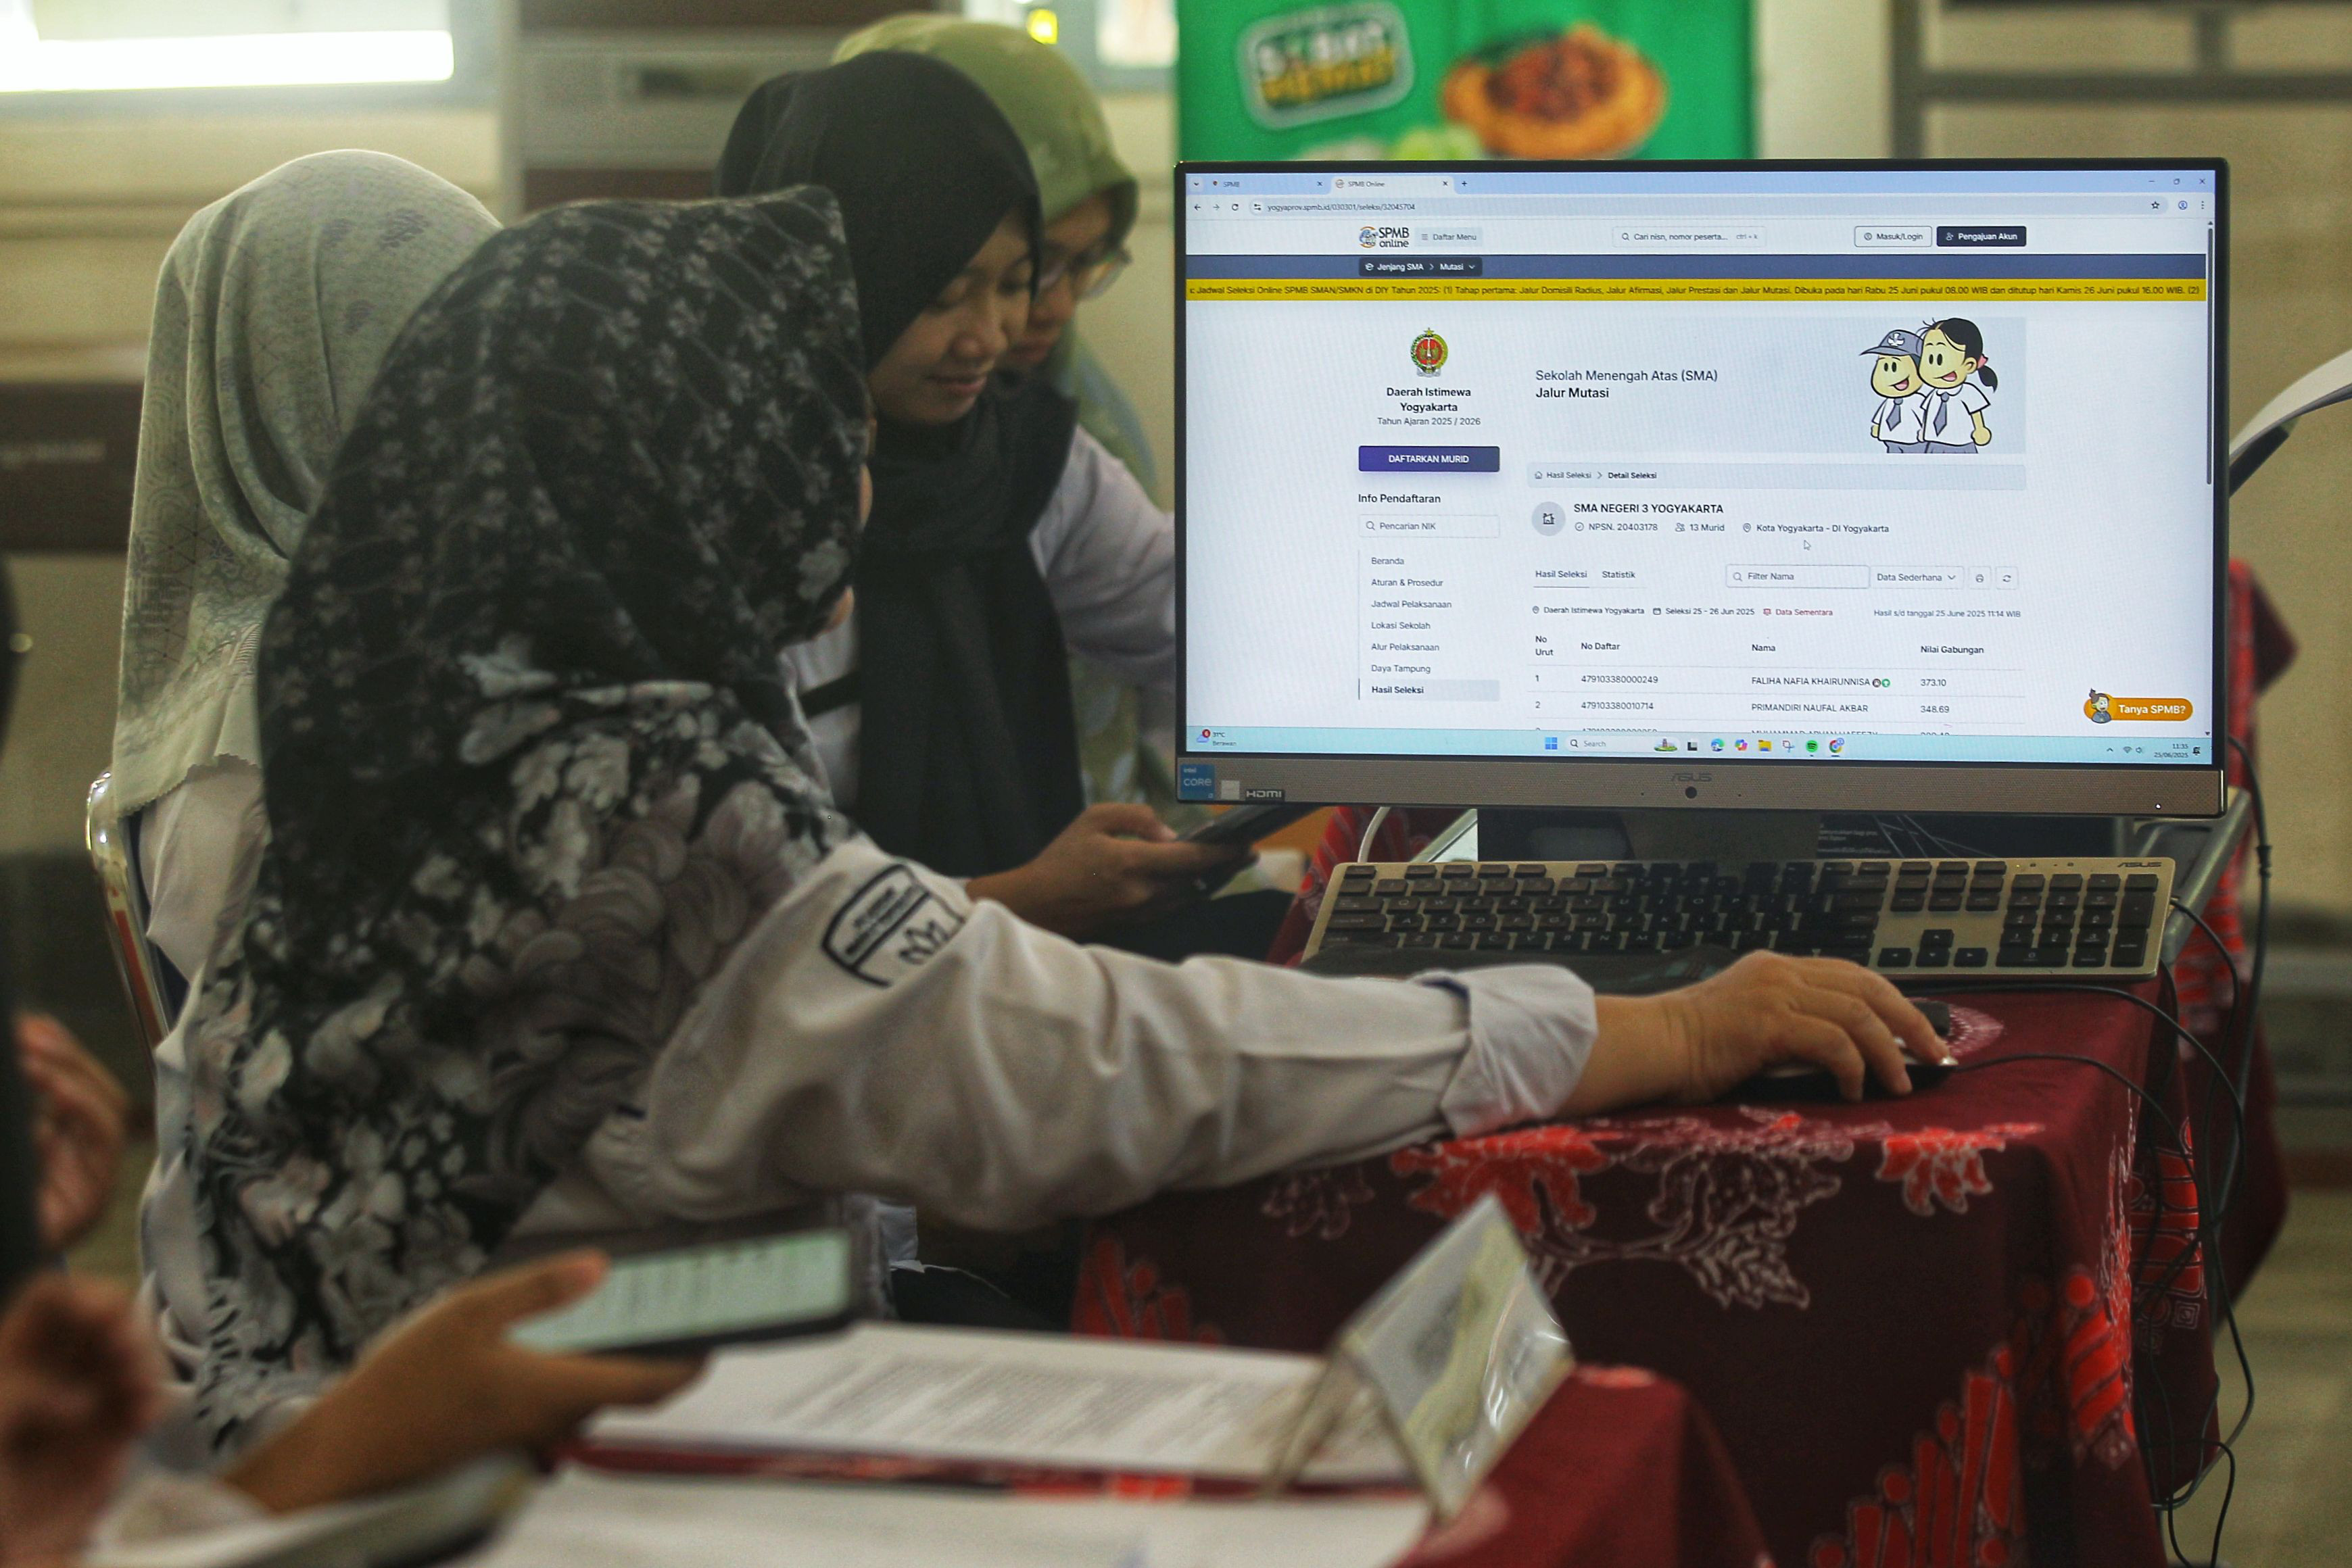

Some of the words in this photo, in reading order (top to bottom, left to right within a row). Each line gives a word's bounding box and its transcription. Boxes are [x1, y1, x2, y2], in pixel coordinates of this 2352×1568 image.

[1378, 226, 1410, 239] SPMB
[1876, 232, 1923, 241] Masuk/Login
[1958, 232, 1997, 242] Pengajuan
[1998, 232, 2018, 241] Akun
[1650, 233, 1667, 242] nisn,
[1378, 239, 1410, 248] online
[1376, 263, 1406, 272] Jenjang
[1443, 287, 1453, 296] (1)
[1456, 287, 1480, 296] Tahap
[1481, 287, 1516, 296] pertama:
[1575, 287, 1604, 296] Radius,
[1825, 287, 1846, 296] pada
[1920, 287, 1943, 296] pukul
[2008, 287, 2037, 296] ditutup
[2117, 287, 2140, 296] pukul
[2188, 287, 2200, 296] (2)
[1535, 370, 1583, 381] Sekolah
[1585, 370, 1648, 383] Menengah
[1651, 370, 1678, 381] Atas
[1681, 370, 1718, 382] (SMA)
[1387, 387, 1423, 397] Daerah
[1425, 387, 1471, 397] Istimewa
[1535, 387, 1566, 398] Jalur
[1568, 387, 1610, 398] Mutasi
[1399, 403, 1458, 413] Yogyakarta
[1378, 417, 1401, 425] Tahun
[1403, 417, 1429, 426] Ajaran
[1389, 455, 1439, 463] DAFTARKAN
[1358, 493, 1378, 503] Info
[1380, 493, 1441, 503] Pendaftaran
[1574, 504, 1598, 514] SMA
[1600, 504, 1639, 514] NEGERI
[1641, 504, 1648, 514] 3
[1650, 504, 1724, 514] YOGYAKARTA
[1589, 523, 1614, 531] NPSN.
[1689, 524, 1698, 532] 13
[1701, 524, 1725, 532] Murid
[1756, 524, 1775, 532] Kota
[1777, 524, 1823, 534] Yogyakarta
[1832, 524, 1841, 533] DI
[1843, 525, 1890, 535] Yogyakarta
[1372, 557, 1404, 565] Beranda
[1602, 570, 1636, 579] Statistik
[1770, 572, 1794, 581] Nama
[1877, 573, 1896, 581] Data
[1898, 574, 1942, 582] Sederhana
[1402, 600, 1452, 608] Pelaksanaan
[1543, 606, 1569, 614] Daerah
[1604, 607, 1645, 616] Yogyakarta
[1874, 609, 1892, 617] Hasil
[1906, 610, 1934, 618] tanggal
[1399, 622, 1431, 630] Sekolah
[1535, 648, 1554, 656] Urut
[1752, 644, 1776, 652] Nama
[1921, 645, 1939, 654] Nilai
[1941, 645, 1984, 656] Gabungan
[1372, 665, 1391, 674] Daya
[1394, 665, 1431, 674] Tampung
[1581, 675, 1658, 683] 479103380000249
[1752, 677, 1782, 685] FALIHA
[1783, 677, 1809, 685] NAFIA
[1811, 677, 1871, 686] KHAIRUNNISA
[1920, 678, 1946, 687] 373.10
[1394, 686, 1424, 694] Seleksi
[1535, 701, 1541, 709] 2
[1581, 701, 1654, 710] 479103380010714
[1752, 703, 1801, 711] PRIMANDIRI
[1803, 704, 1837, 712] NAUFAL
[1840, 704, 1869, 712] AKBAR
[1920, 705, 1950, 714] 348.69
[2119, 704, 2148, 715] Tanya
[2151, 705, 2186, 714] SPMB?
[1671, 773, 1713, 782] ASUS
[1246, 790, 1282, 798] HDMI
